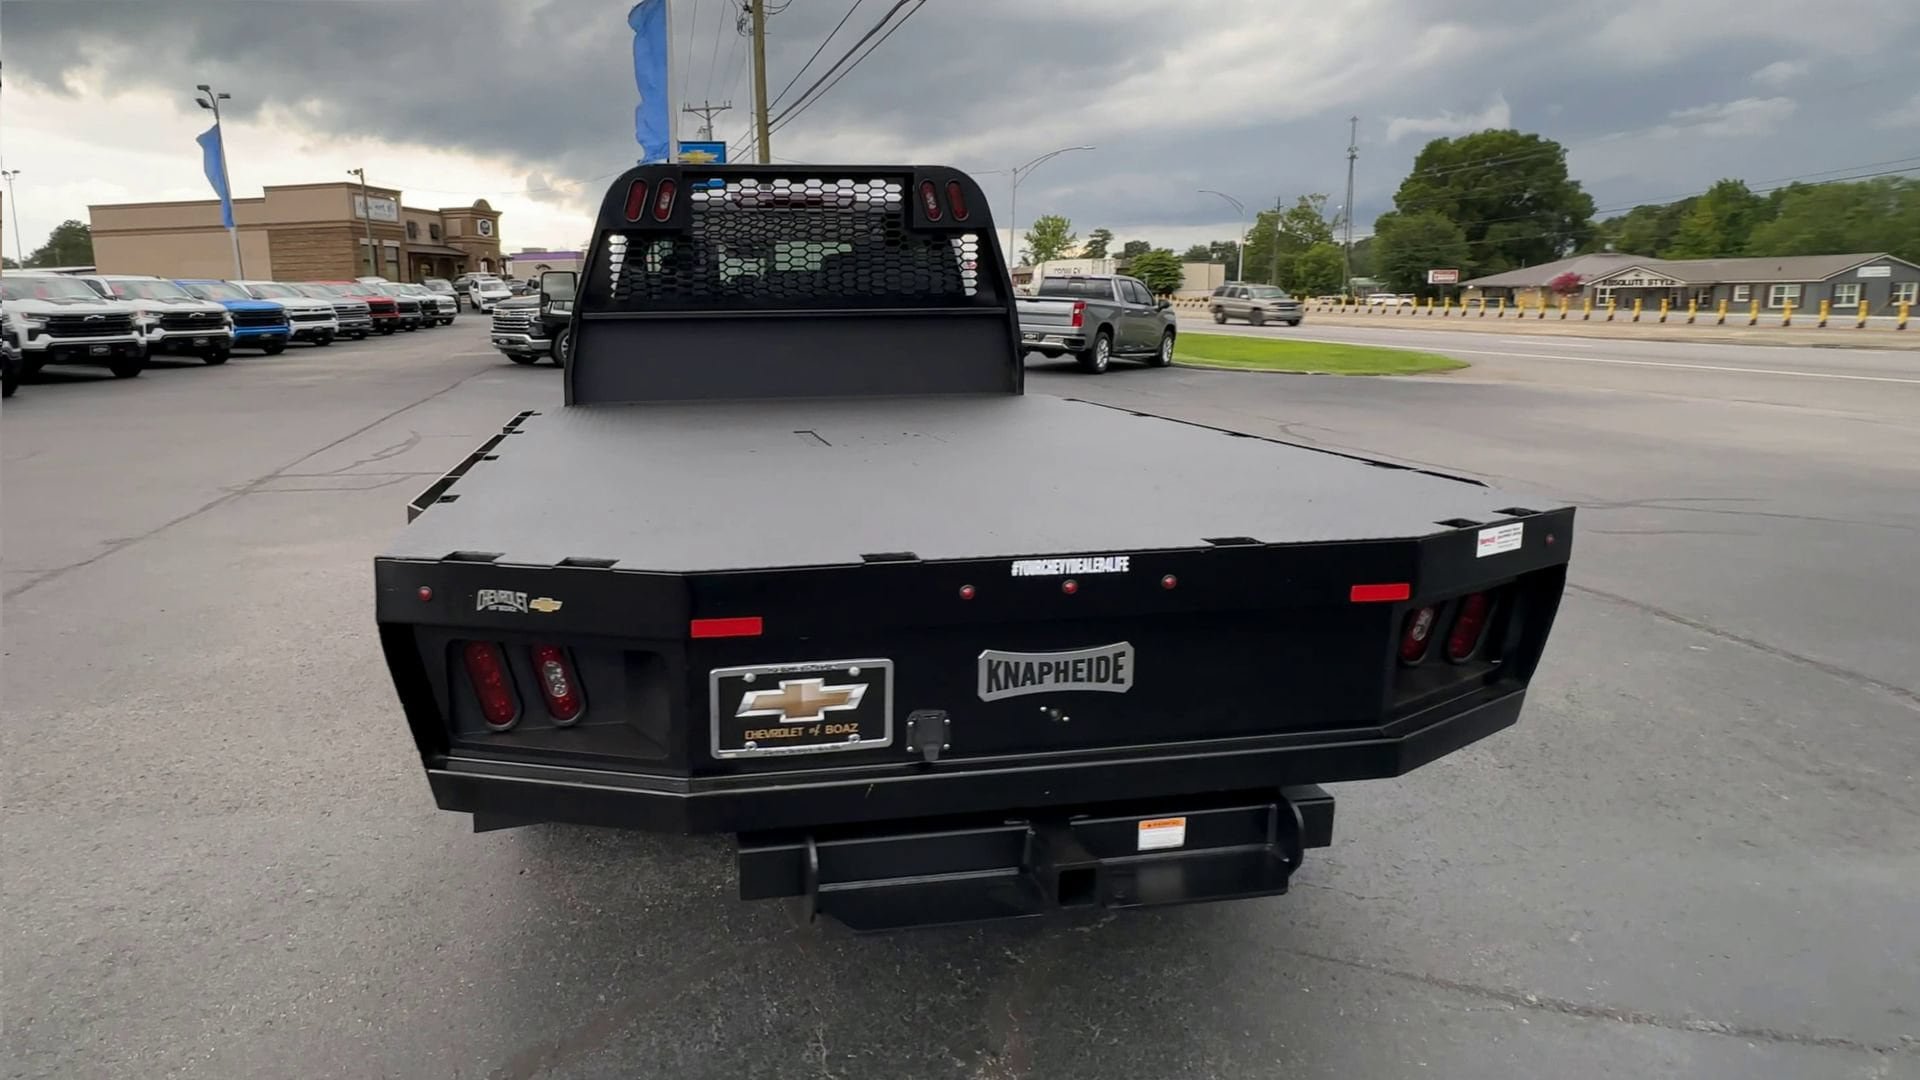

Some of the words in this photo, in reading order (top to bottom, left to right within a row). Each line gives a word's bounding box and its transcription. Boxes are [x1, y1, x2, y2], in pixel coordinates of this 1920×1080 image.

[1647, 278, 1675, 286] STYLE
[476, 589, 529, 614] CHEVROLET
[986, 650, 1126, 694] KNAPHEIDE
[744, 726, 805, 741] CHEVROLET
[808, 724, 821, 737] of
[825, 722, 860, 735] BOAZ
